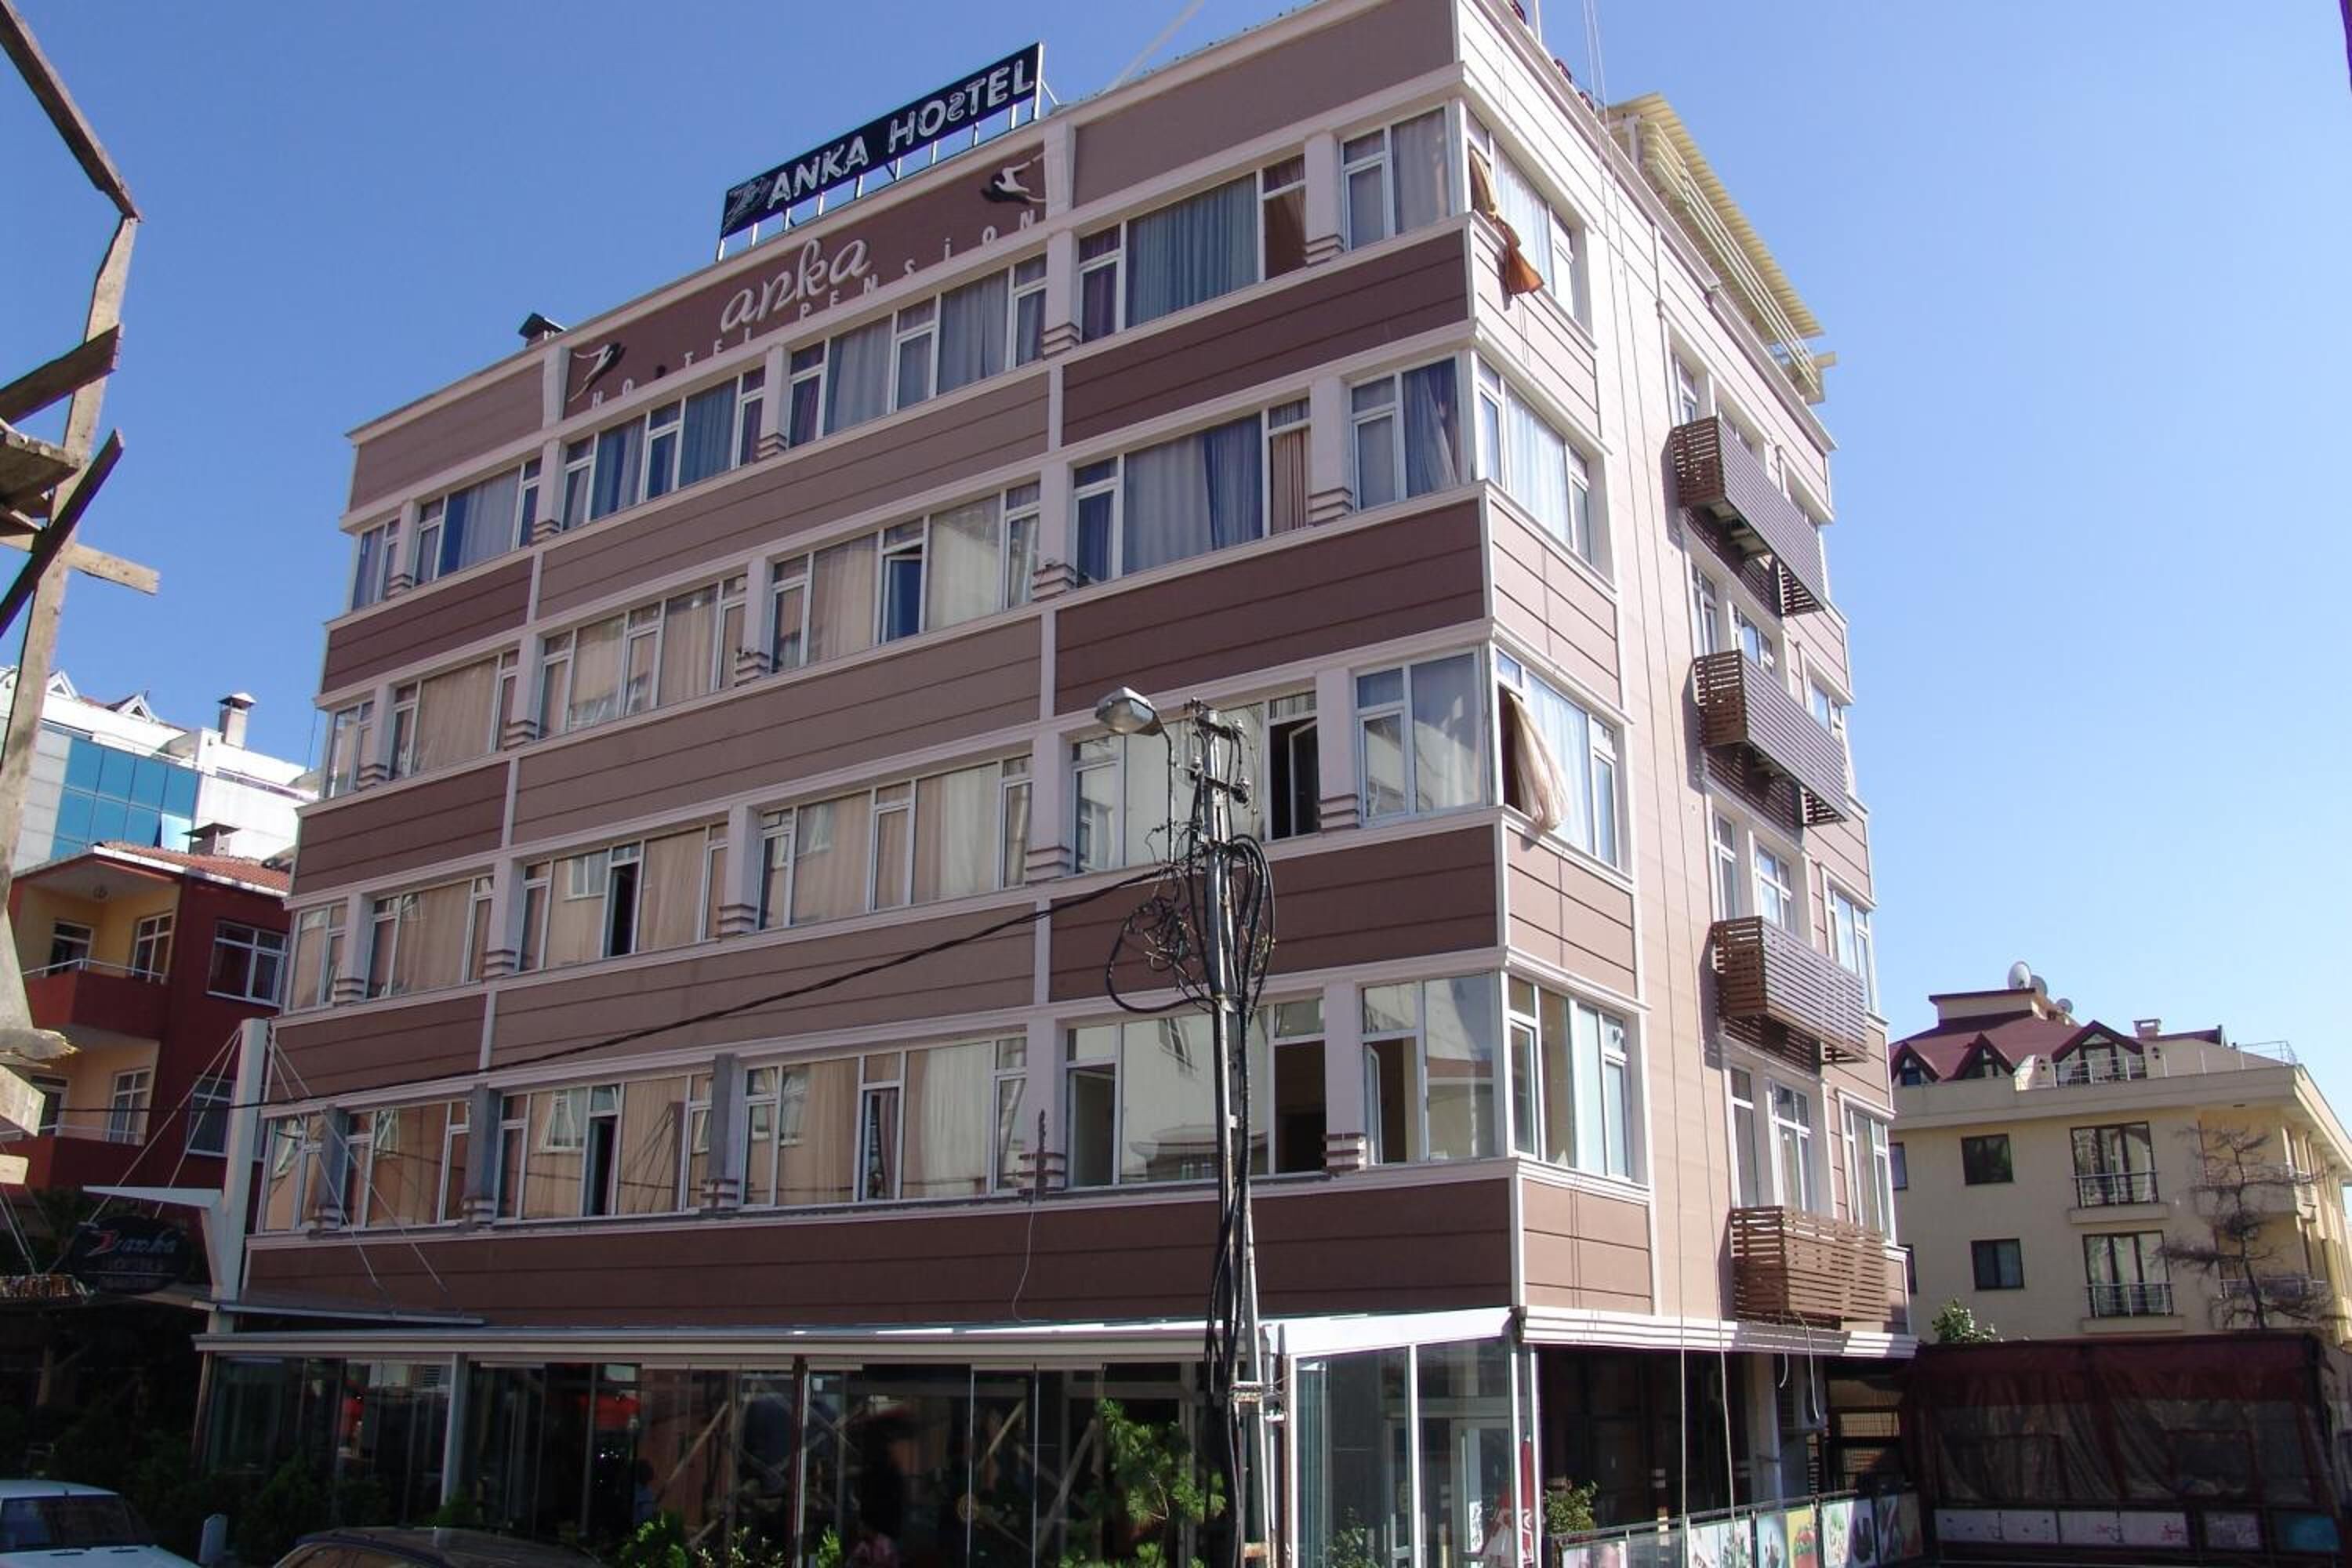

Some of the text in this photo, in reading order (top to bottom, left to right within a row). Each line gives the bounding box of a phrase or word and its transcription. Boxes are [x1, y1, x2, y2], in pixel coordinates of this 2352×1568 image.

[767, 59, 1035, 210] ANKA HOSTEL
[720, 238, 872, 333] anka
